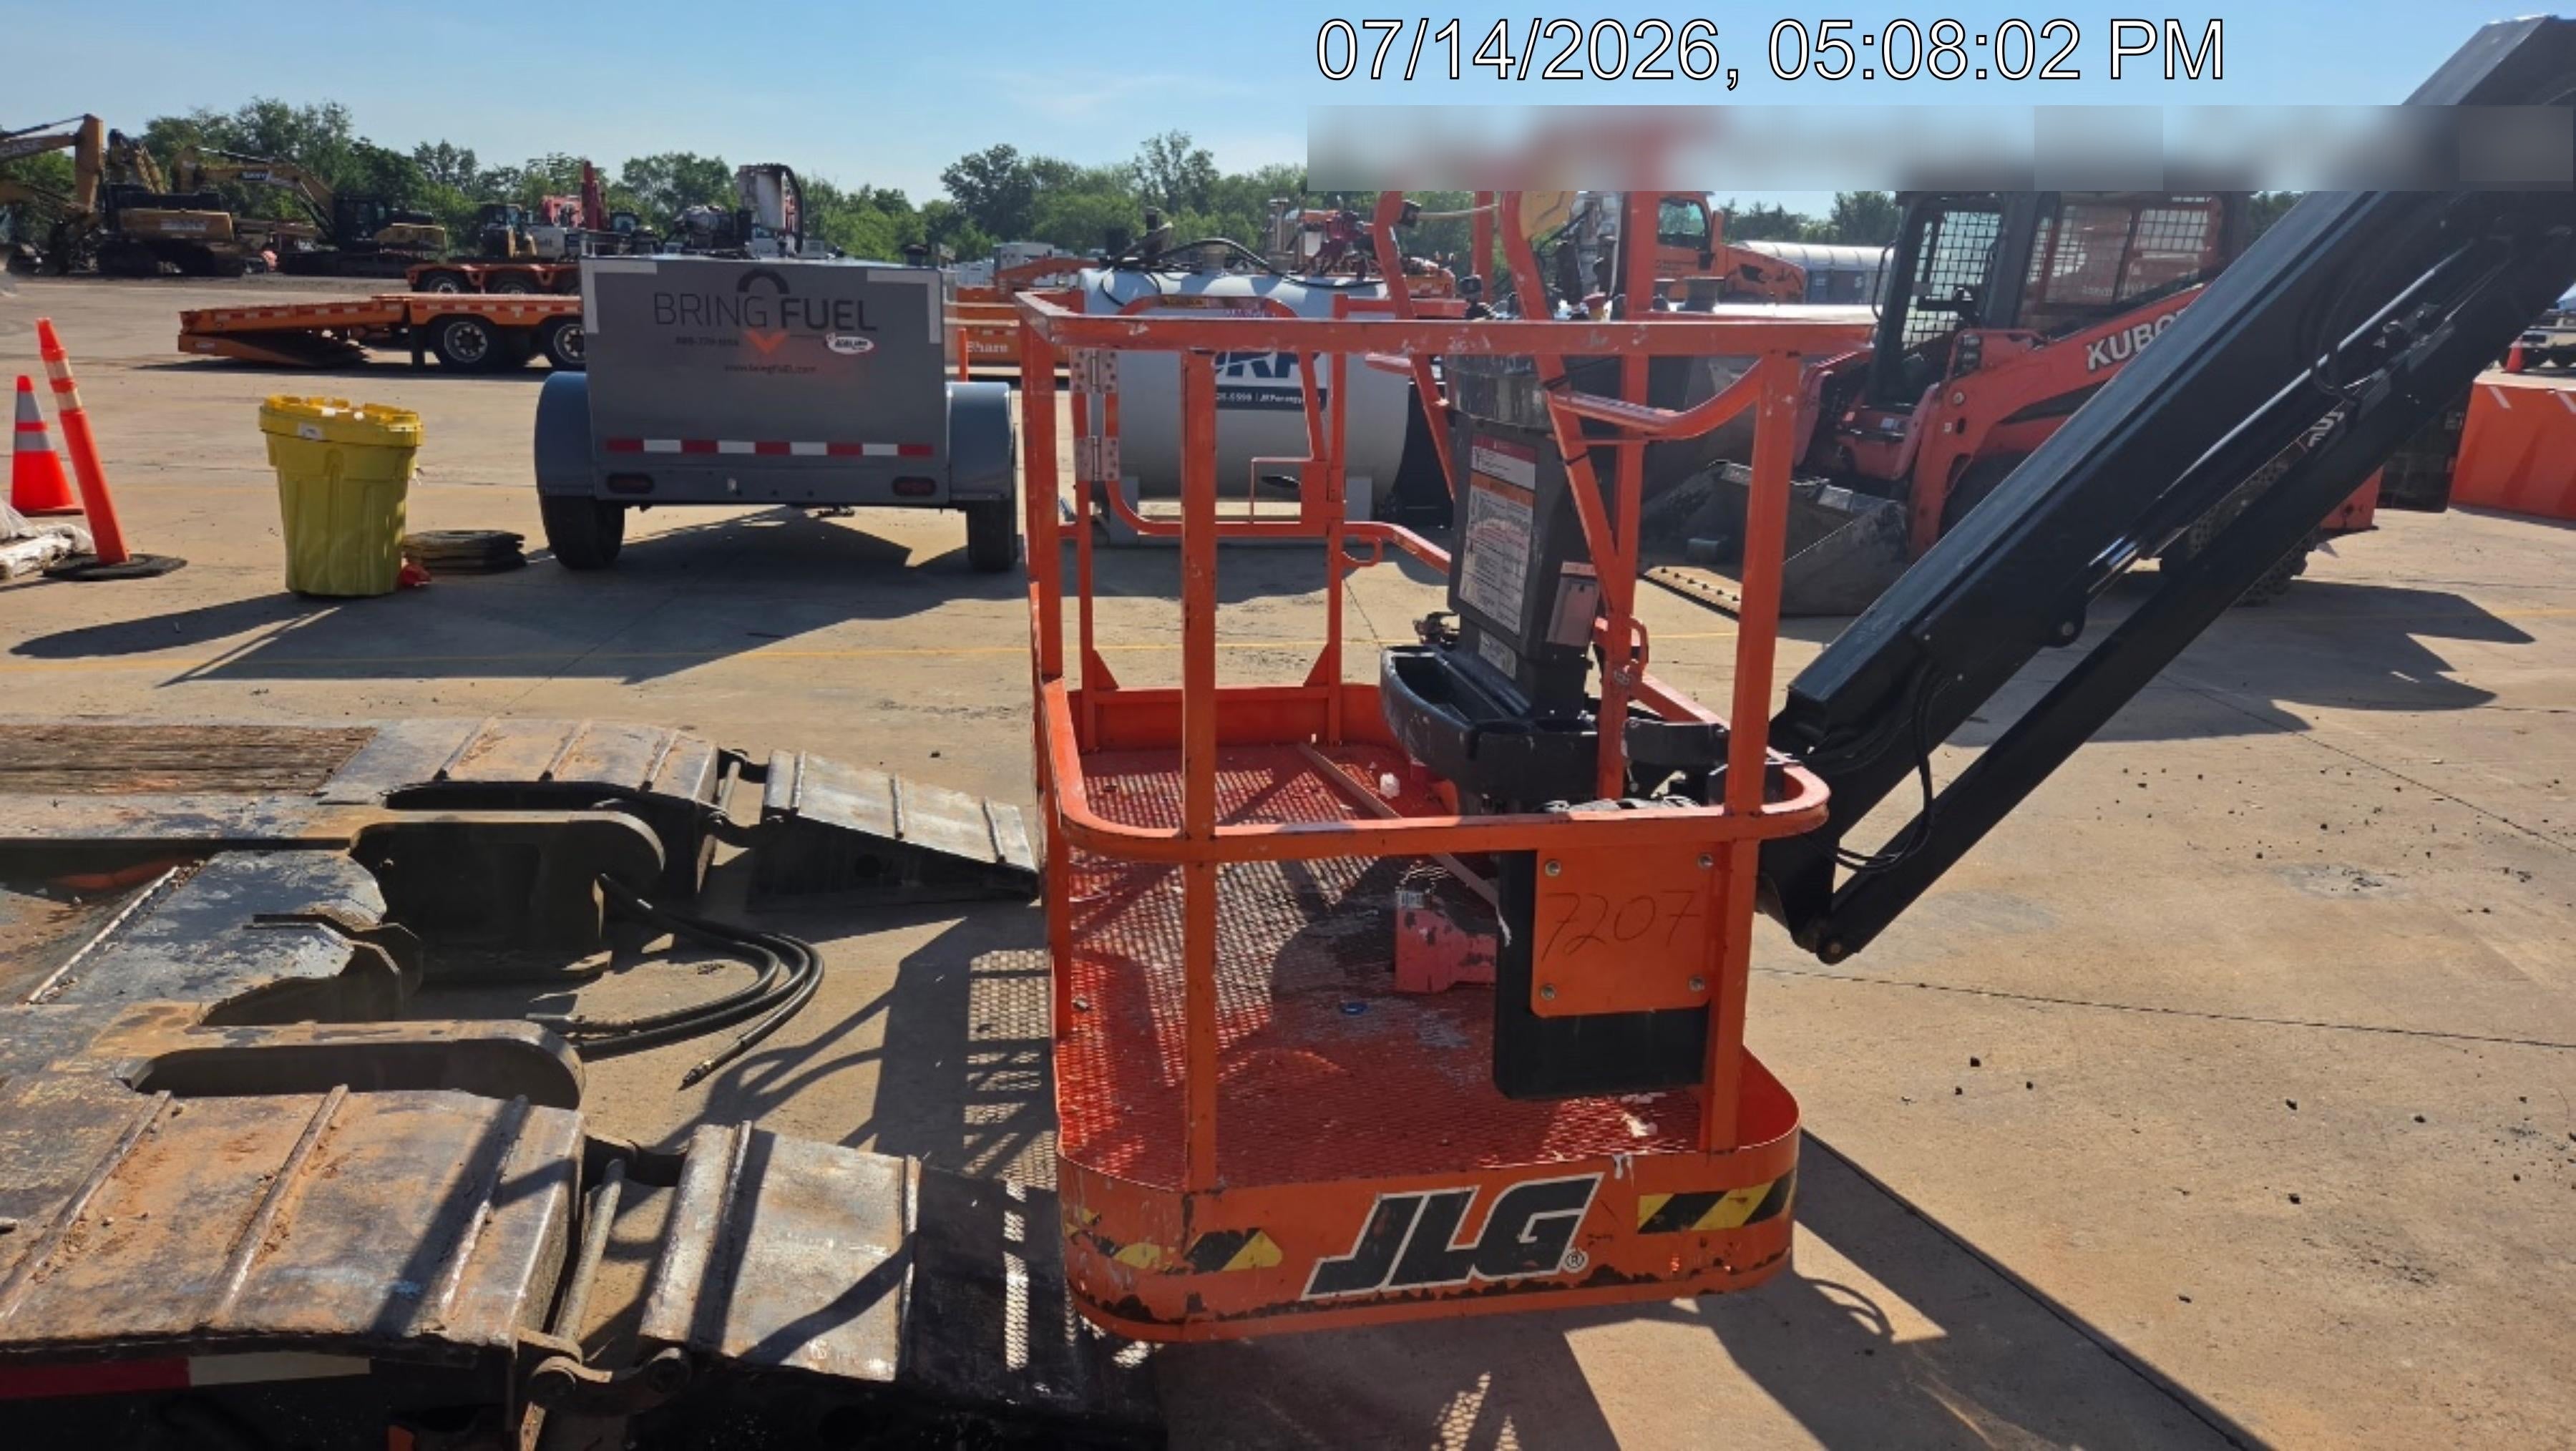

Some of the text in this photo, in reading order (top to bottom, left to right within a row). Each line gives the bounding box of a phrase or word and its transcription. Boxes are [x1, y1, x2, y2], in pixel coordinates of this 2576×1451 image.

[654, 292, 878, 332] BRING FUEL
[1541, 889, 1702, 962] 7207
[1301, 1172, 1605, 1301] JLG
